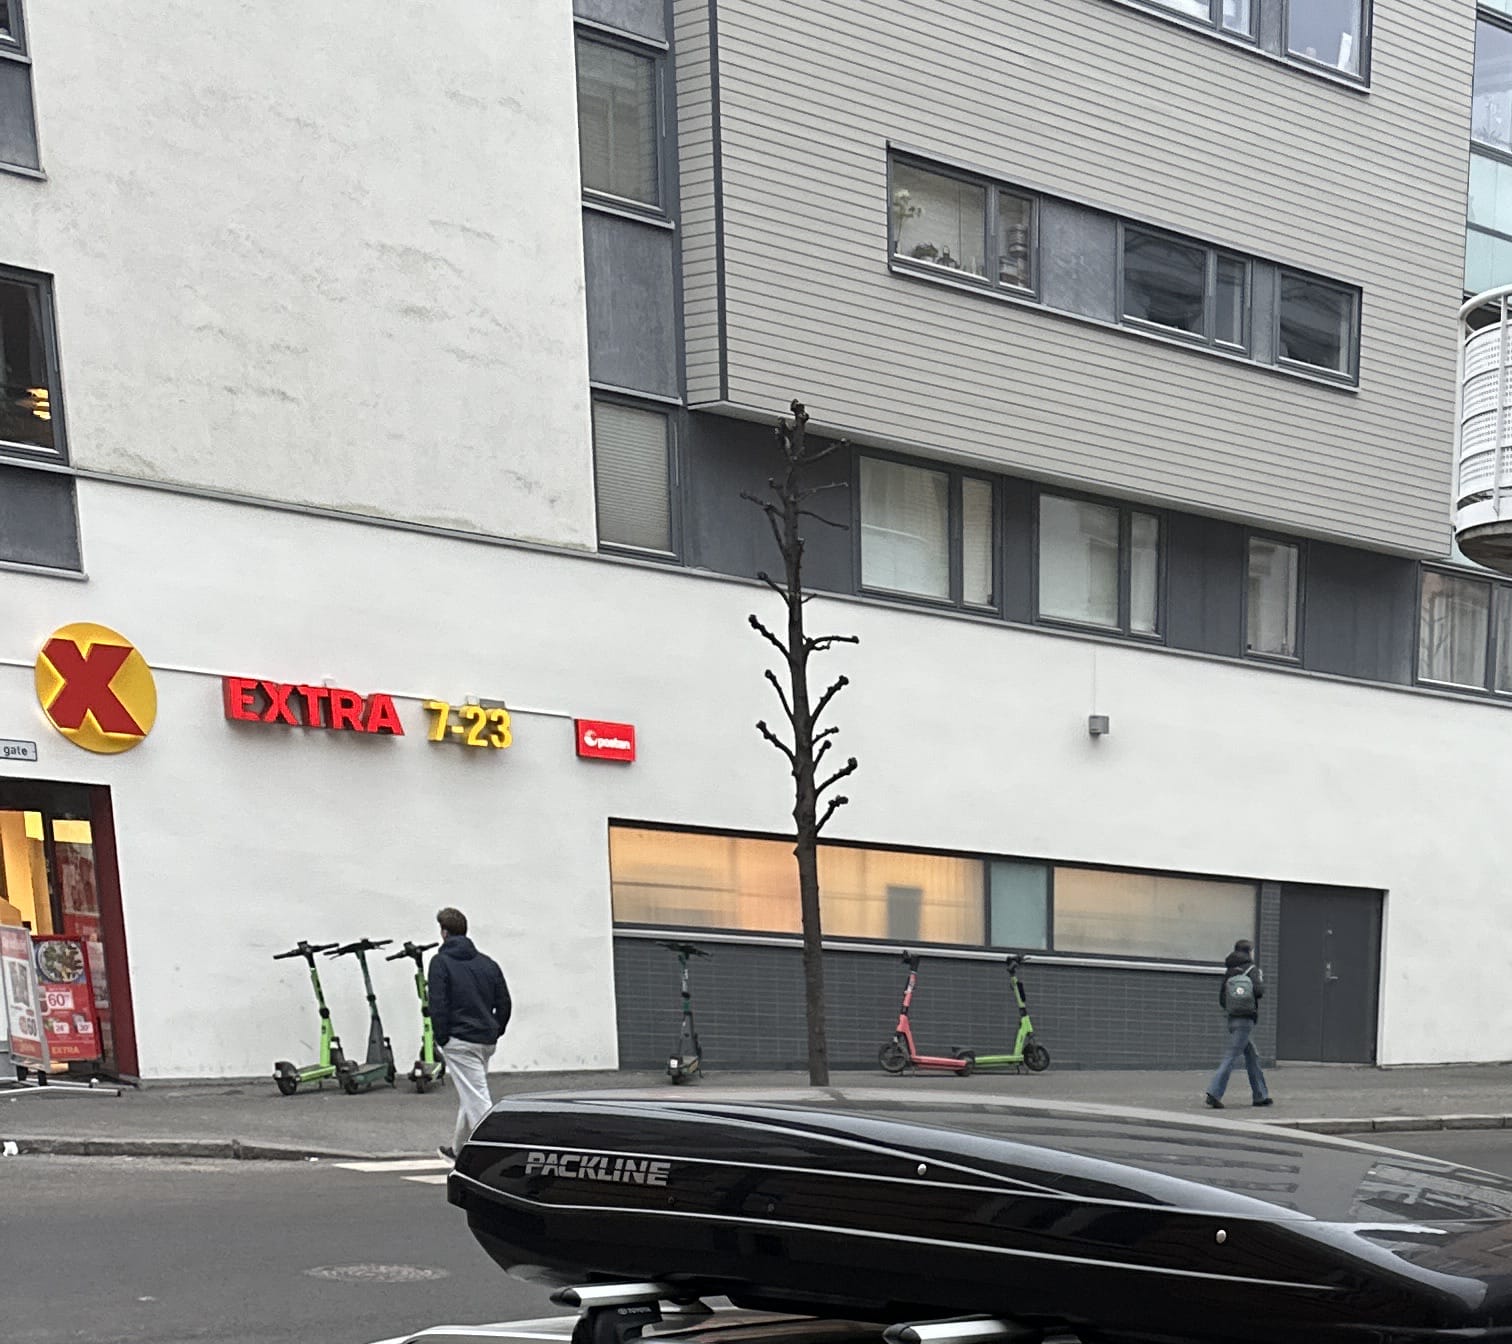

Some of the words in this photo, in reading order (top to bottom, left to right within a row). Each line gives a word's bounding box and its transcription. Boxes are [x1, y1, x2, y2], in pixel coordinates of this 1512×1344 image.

[41, 638, 147, 736] X
[223, 676, 405, 737] EXTRA
[423, 698, 512, 750] 7-23
[524, 1151, 672, 1187] PACKLINE
